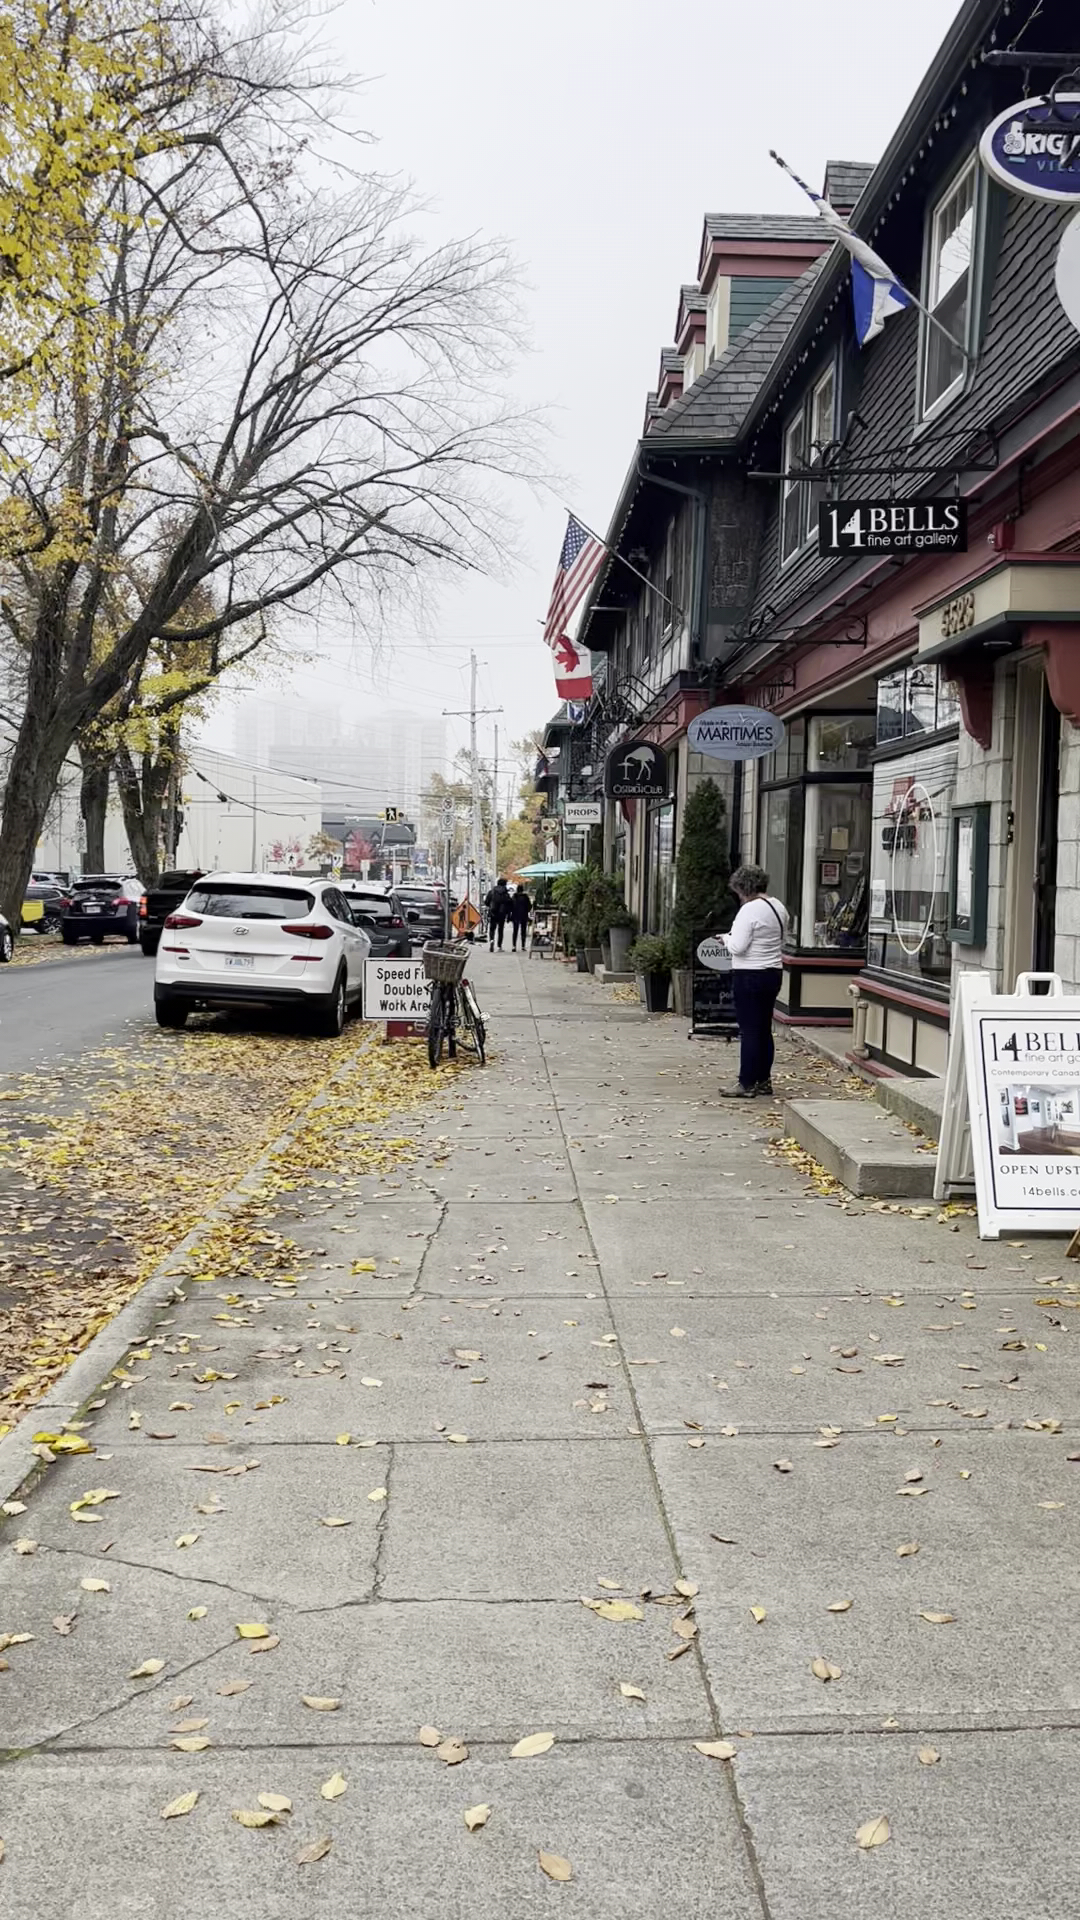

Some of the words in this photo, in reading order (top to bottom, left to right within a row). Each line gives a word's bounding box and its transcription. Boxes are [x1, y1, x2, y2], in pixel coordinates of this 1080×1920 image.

[1003, 120, 1080, 156] BRIG
[1036, 160, 1080, 172] VILL
[827, 508, 866, 548] 14
[868, 505, 959, 533] BELLS
[867, 534, 891, 547] fine
[894, 534, 912, 546] art
[914, 533, 958, 548] gallery
[696, 726, 773, 741] MARITIMES
[567, 808, 599, 816] PROPS
[376, 967, 411, 982] Speed
[384, 983, 423, 996] Double
[379, 999, 407, 1011] Work
[989, 1031, 1023, 1062] 14
[1025, 1053, 1045, 1063] fine
[1048, 1053, 1064, 1063] art
[990, 1069, 1049, 1077] Contemporary
[1000, 1165, 1039, 1175] OPEN
